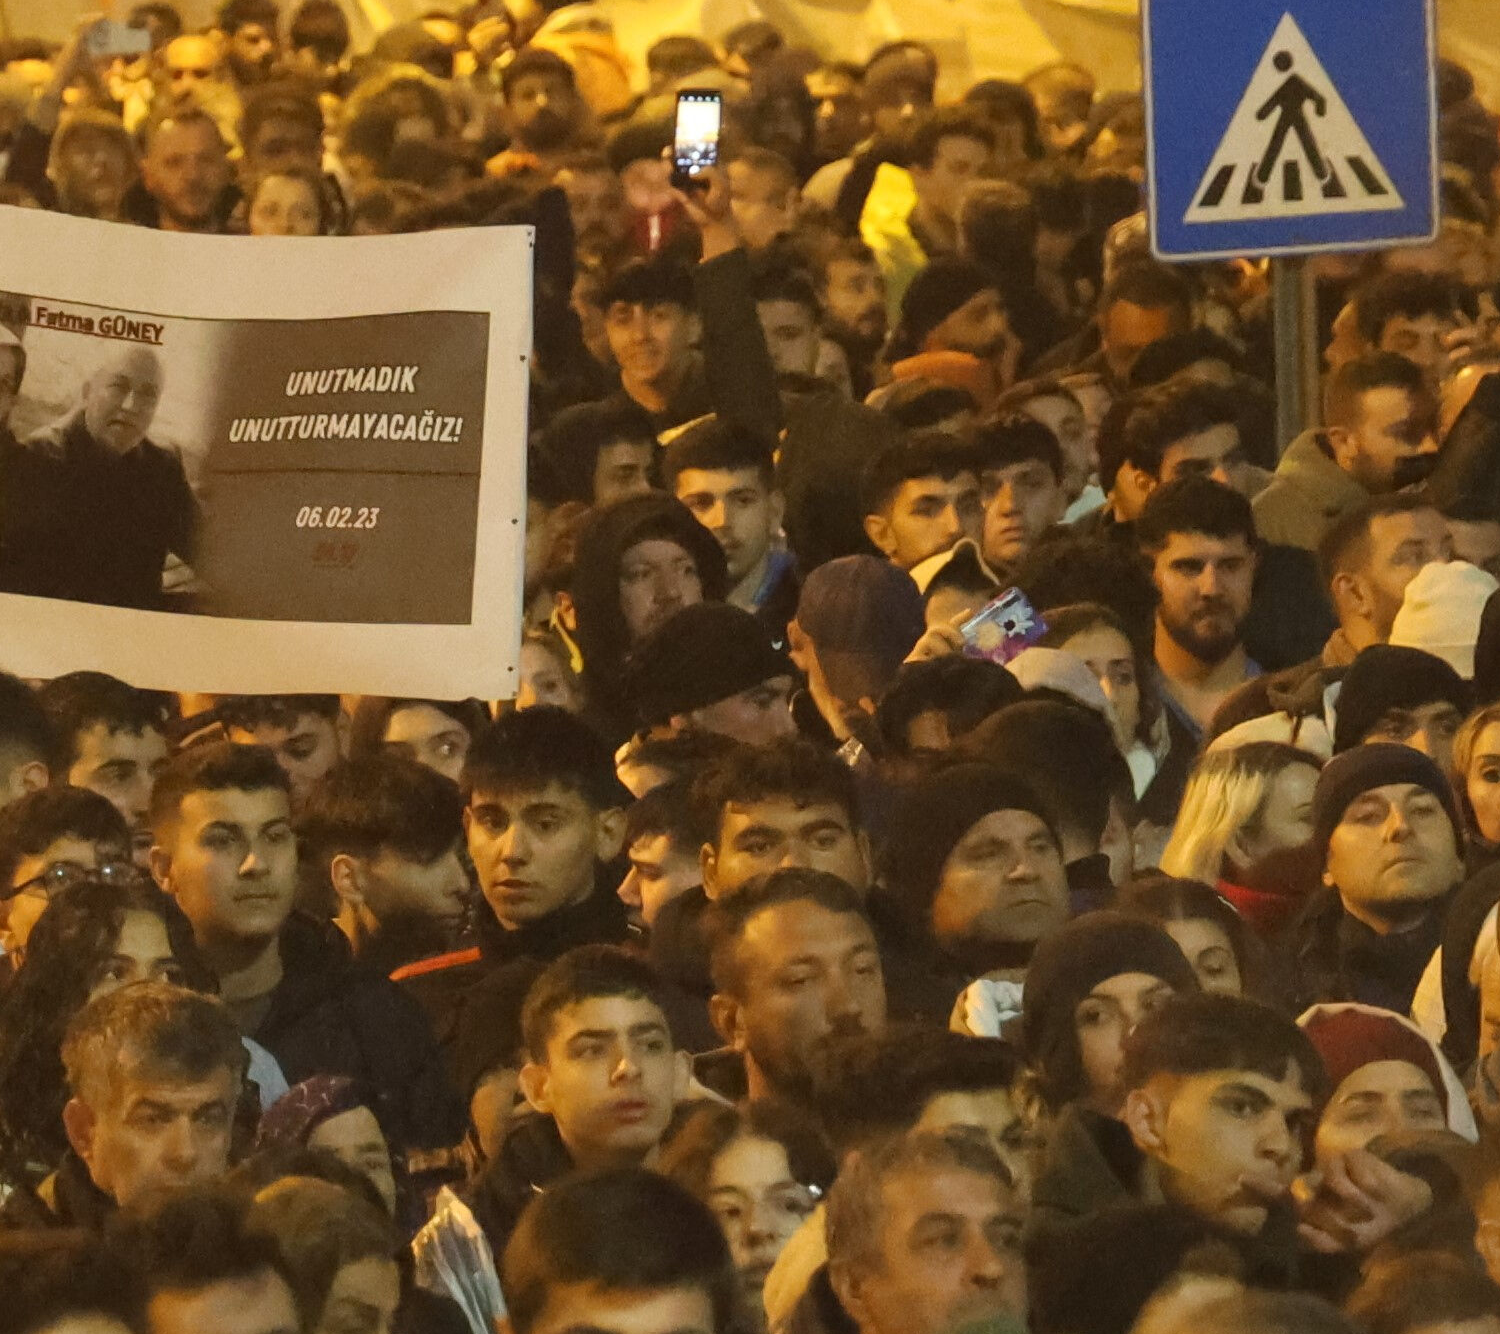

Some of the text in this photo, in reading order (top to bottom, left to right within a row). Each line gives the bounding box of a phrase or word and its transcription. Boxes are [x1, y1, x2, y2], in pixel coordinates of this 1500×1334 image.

[284, 364, 419, 397] UNUTMADIK
[228, 409, 464, 444] UNUTTURMAYACAĞIZ!
[294, 505, 381, 529] 06.02.23
